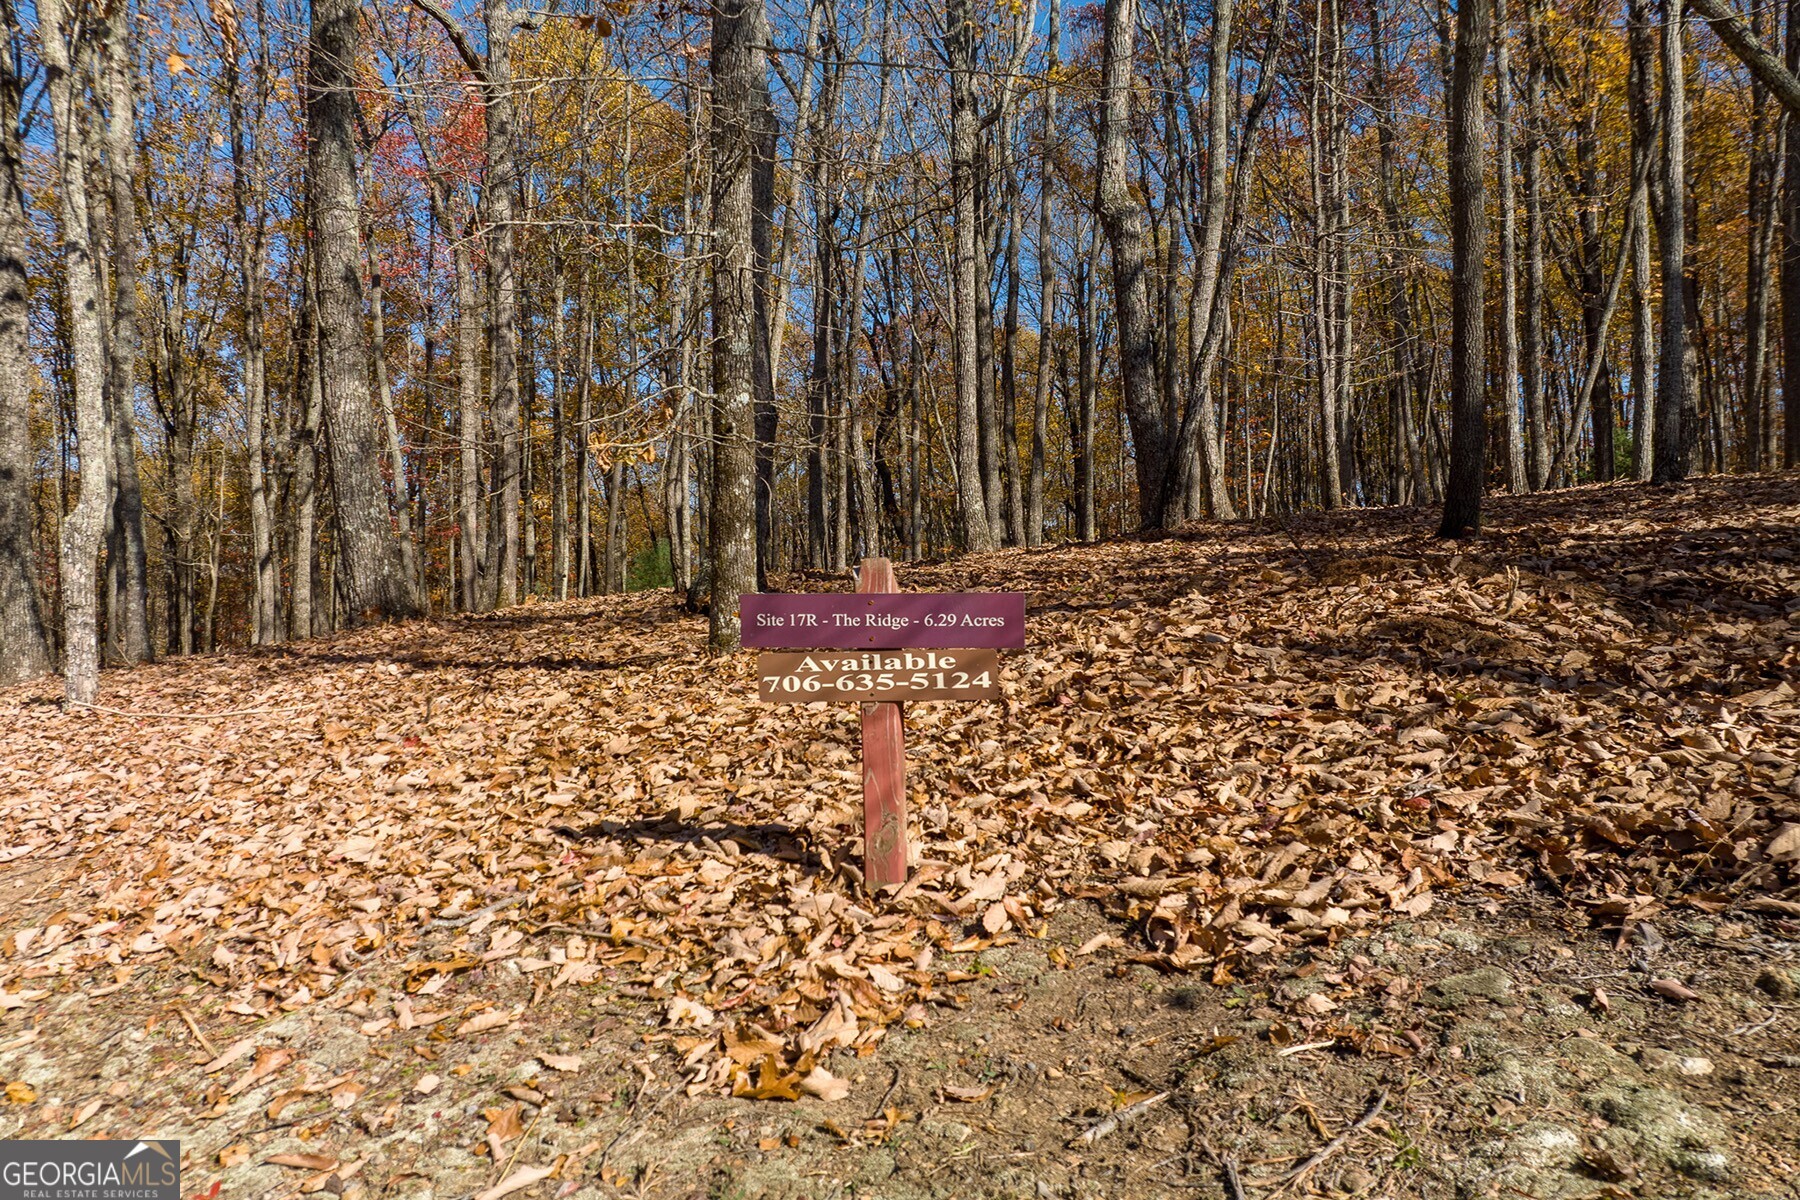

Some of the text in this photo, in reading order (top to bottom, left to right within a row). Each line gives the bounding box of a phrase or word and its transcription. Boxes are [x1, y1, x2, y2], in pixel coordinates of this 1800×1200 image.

[756, 613, 785, 627] Site
[790, 613, 818, 627] 17R
[832, 613, 861, 627] The
[865, 613, 909, 630] Ridge
[924, 613, 957, 627] 6.29
[960, 613, 1005, 627] Acres
[794, 652, 957, 673] Available
[762, 671, 992, 693] 706-635-5124
